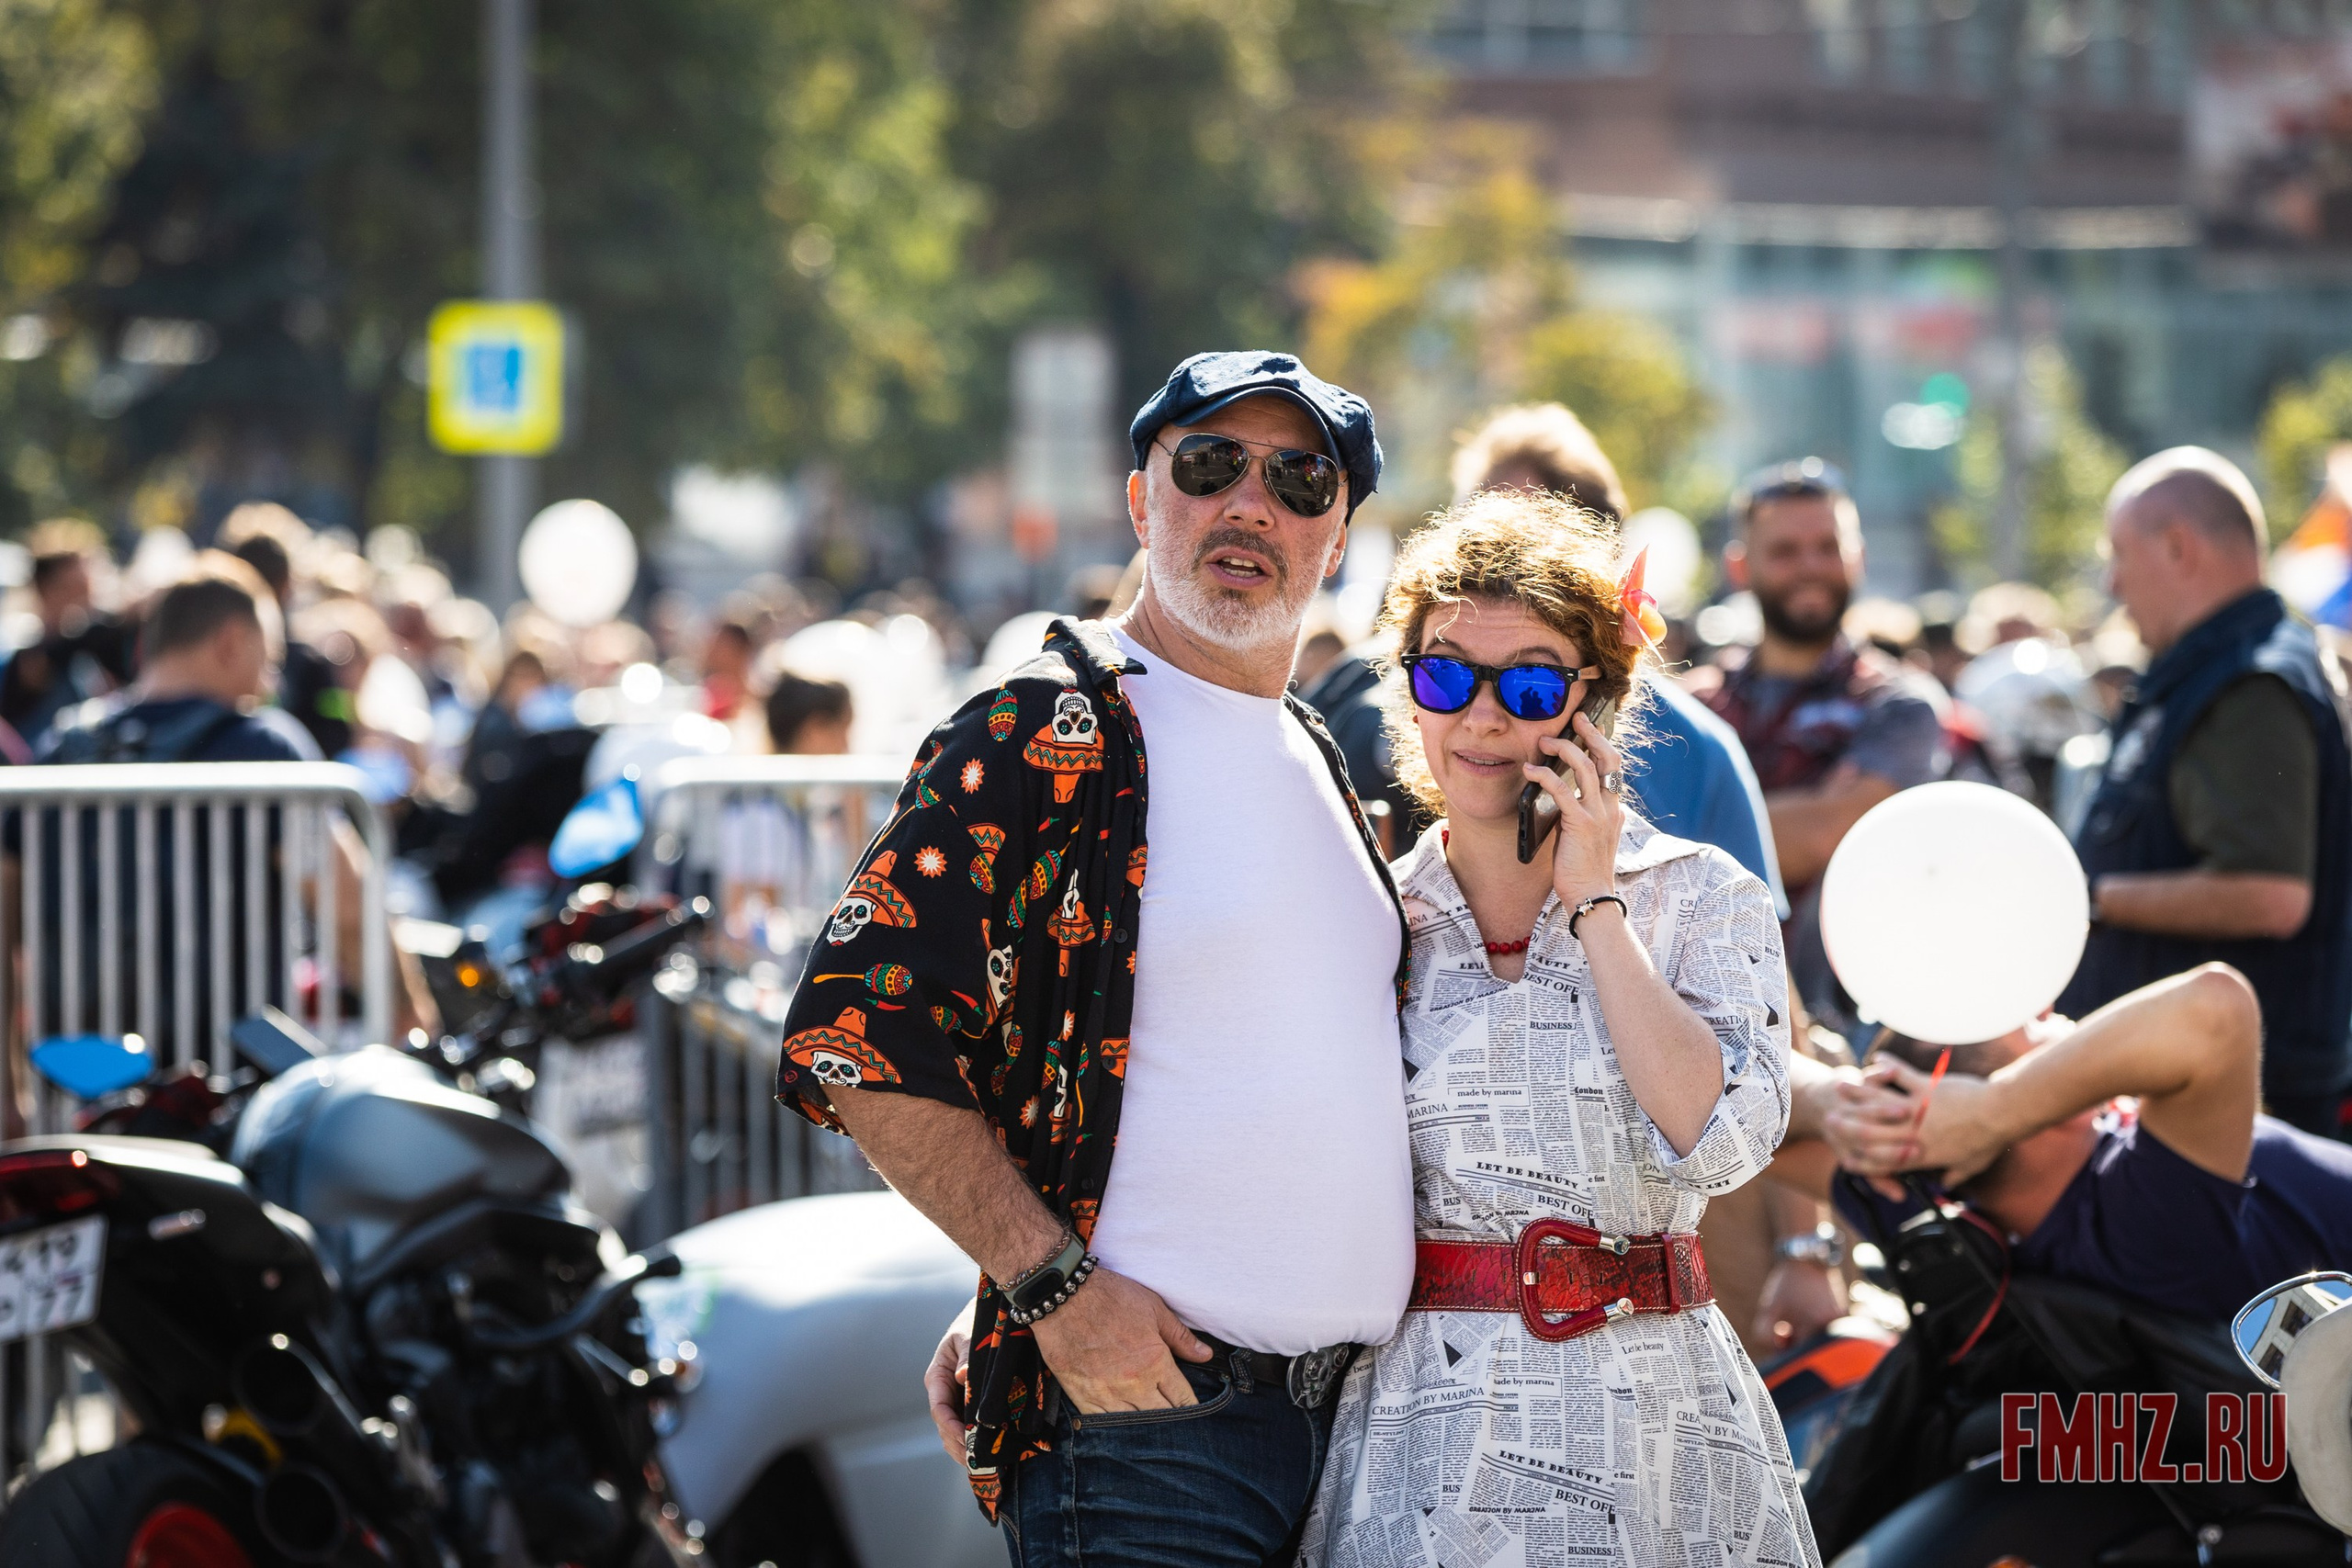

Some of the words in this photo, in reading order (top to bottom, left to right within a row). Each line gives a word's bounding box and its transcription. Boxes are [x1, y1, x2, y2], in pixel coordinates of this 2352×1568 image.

[1530, 1021, 1573, 1030] BUSINESS
[1482, 1088, 1491, 1099] by
[1574, 1086, 1603, 1095] London
[1476, 1161, 1503, 1173] LET
[1507, 1167, 1523, 1176] BE
[1527, 1170, 1578, 1190] BEAUTY
[1537, 1195, 1570, 1211] BEST
[1513, 1378, 1523, 1387] by
[1372, 1395, 1421, 1416] CREATION
[1423, 1393, 1438, 1405] BY
[1440, 1387, 1485, 1402] MARINA
[1714, 1426, 1729, 1437] BY
[1499, 1450, 1525, 1463] LET
[1529, 1459, 1544, 1468] BE
[1549, 1463, 1602, 1484] BEAUTY
[1620, 1471, 1635, 1479] first
[1555, 1488, 1589, 1507] BEST
[1567, 1546, 1612, 1555] BUSINESS
